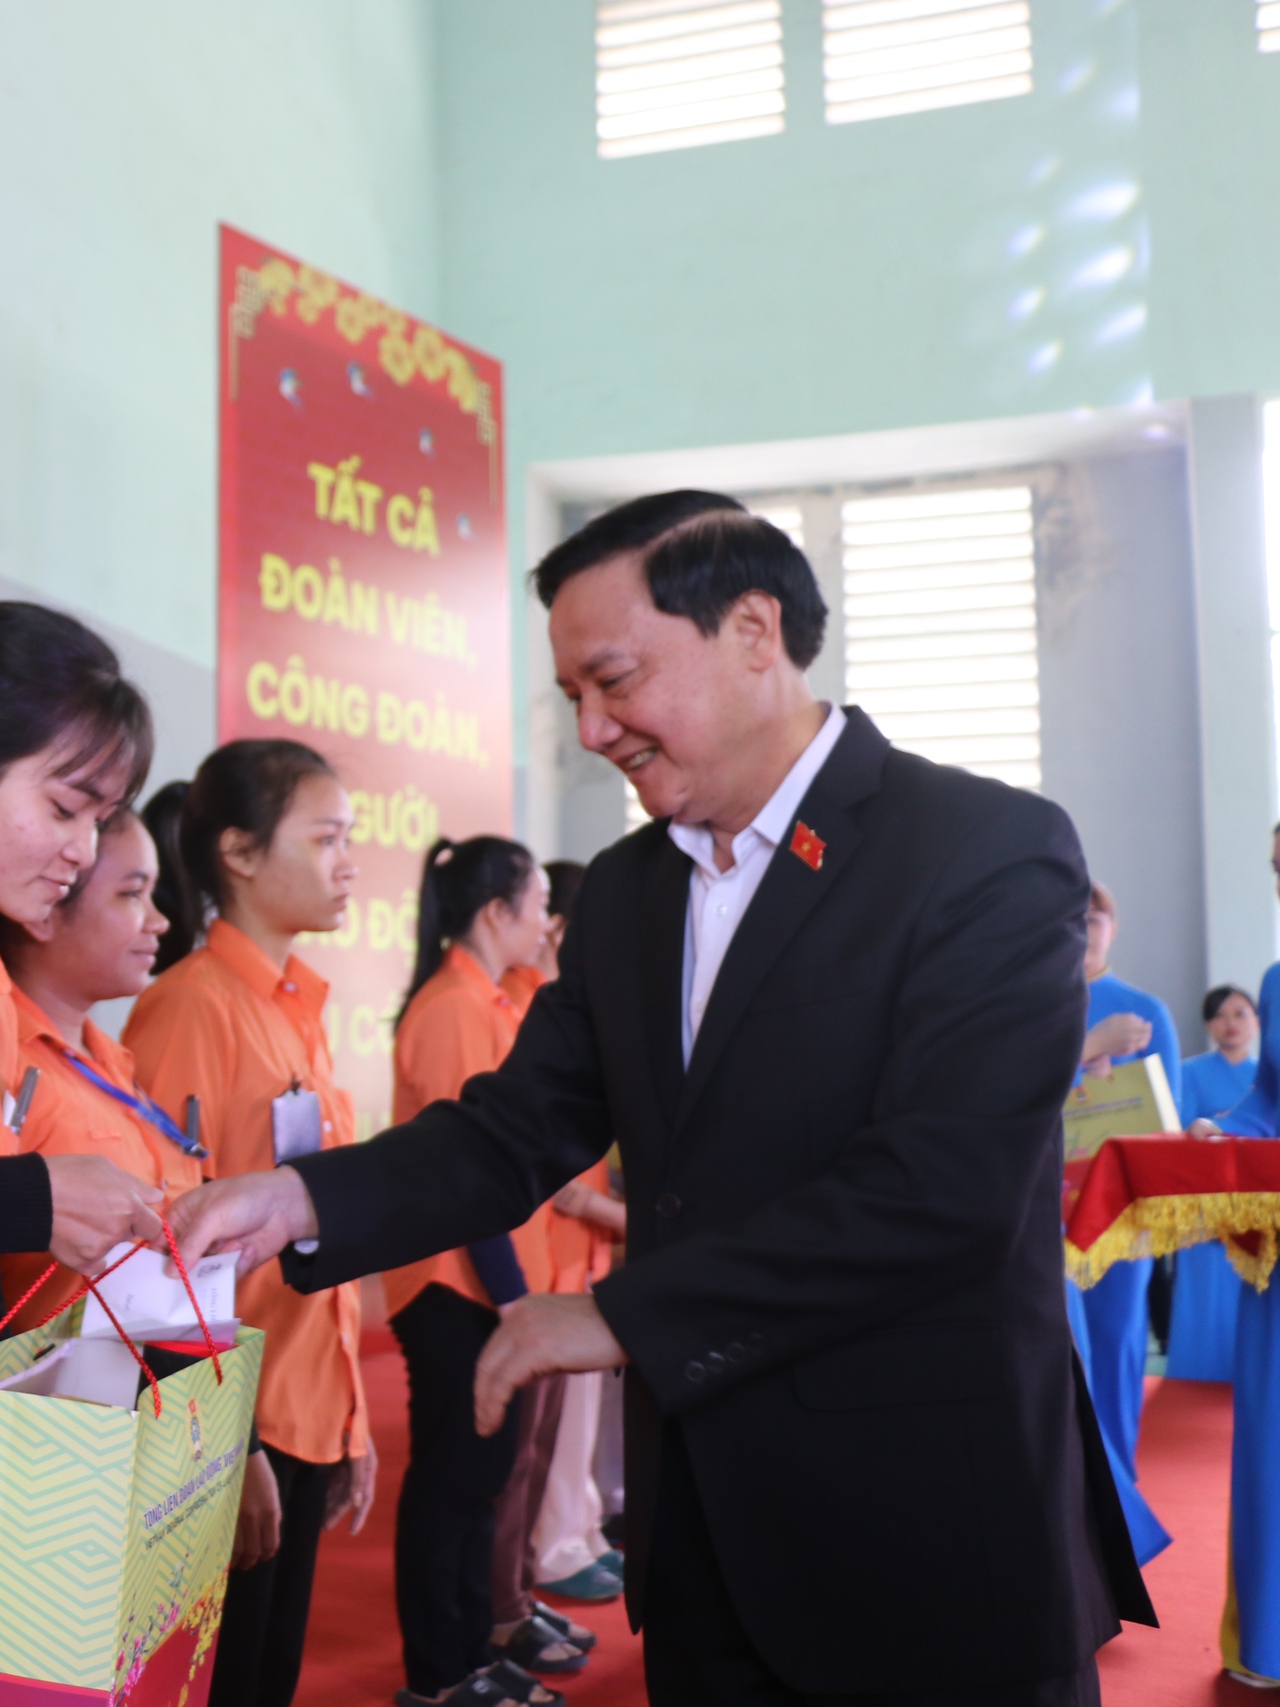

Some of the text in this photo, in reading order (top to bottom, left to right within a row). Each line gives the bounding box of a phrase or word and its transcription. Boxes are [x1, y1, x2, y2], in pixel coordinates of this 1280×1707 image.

[306, 454, 441, 557] TẤT CẢ
[258, 552, 380, 637] ĐOÀN
[246, 654, 370, 738] CÔNG
[348, 784, 438, 852] GƯỜI
